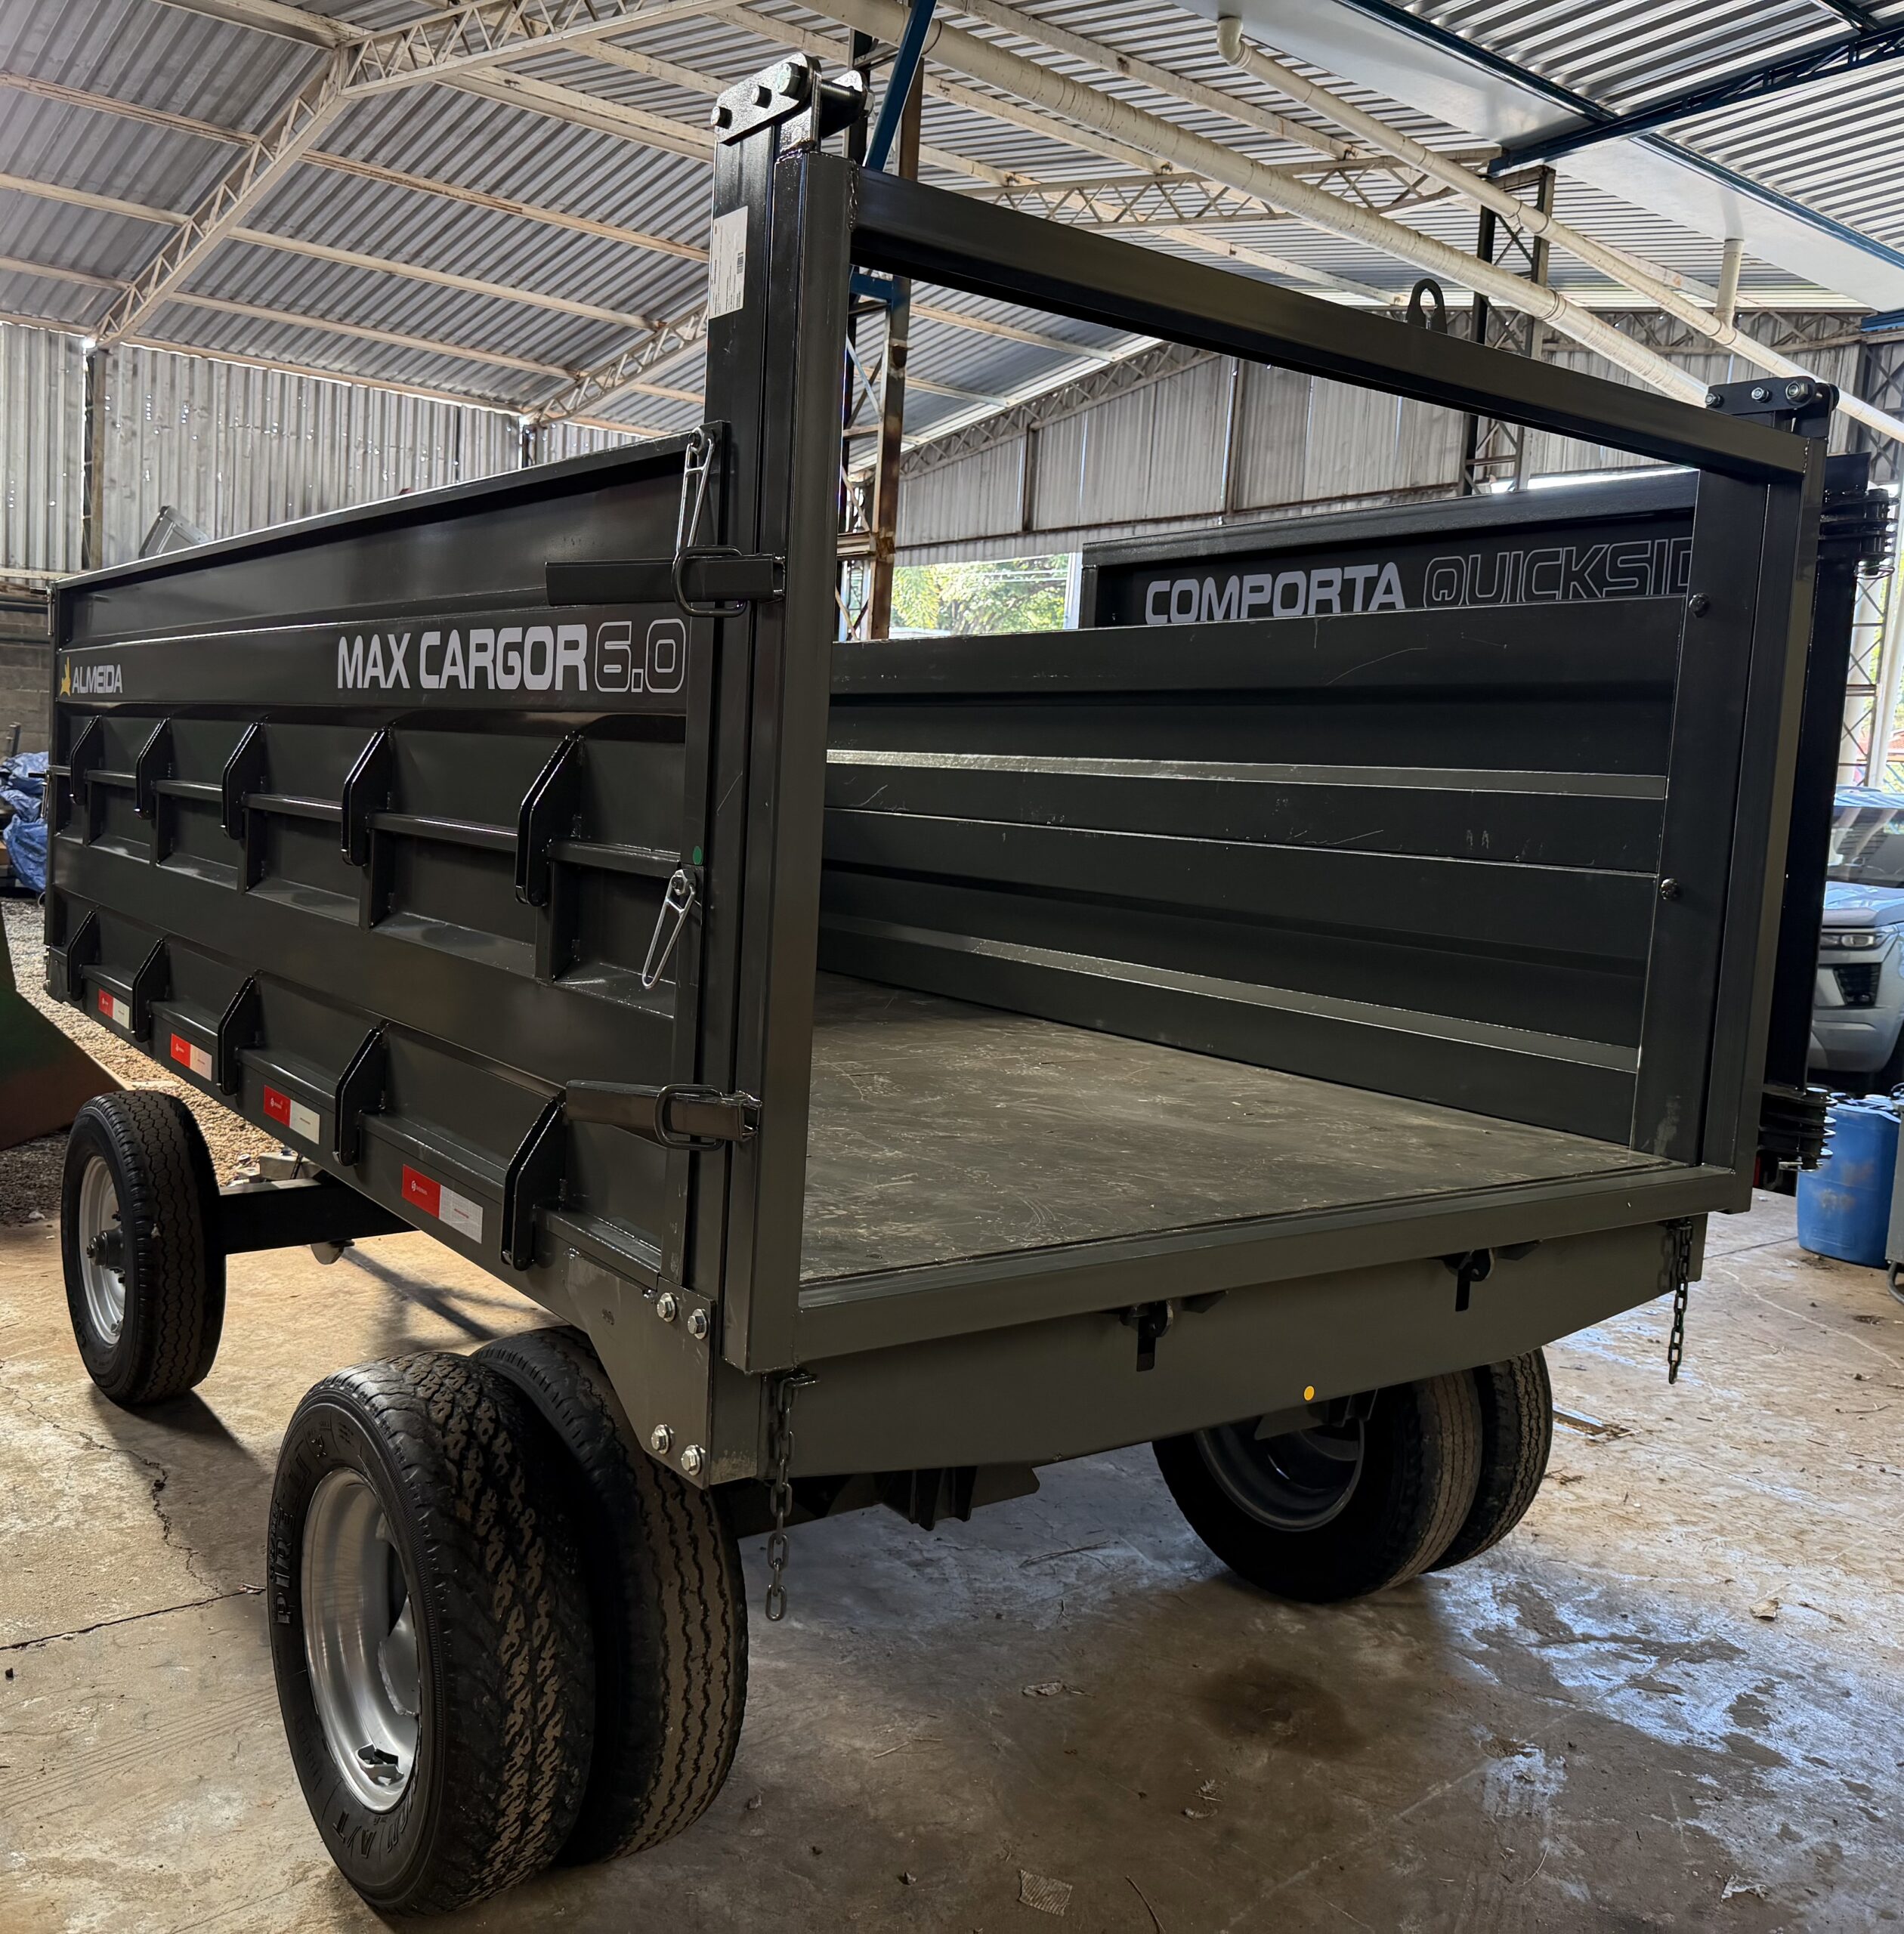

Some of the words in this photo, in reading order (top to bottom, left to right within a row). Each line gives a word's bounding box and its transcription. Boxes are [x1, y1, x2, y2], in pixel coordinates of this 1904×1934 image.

[1145, 561, 1406, 625] COMPORTA
[337, 632, 411, 689] MAX
[419, 623, 588, 691] CARGOR
[595, 618, 687, 694] 6.0
